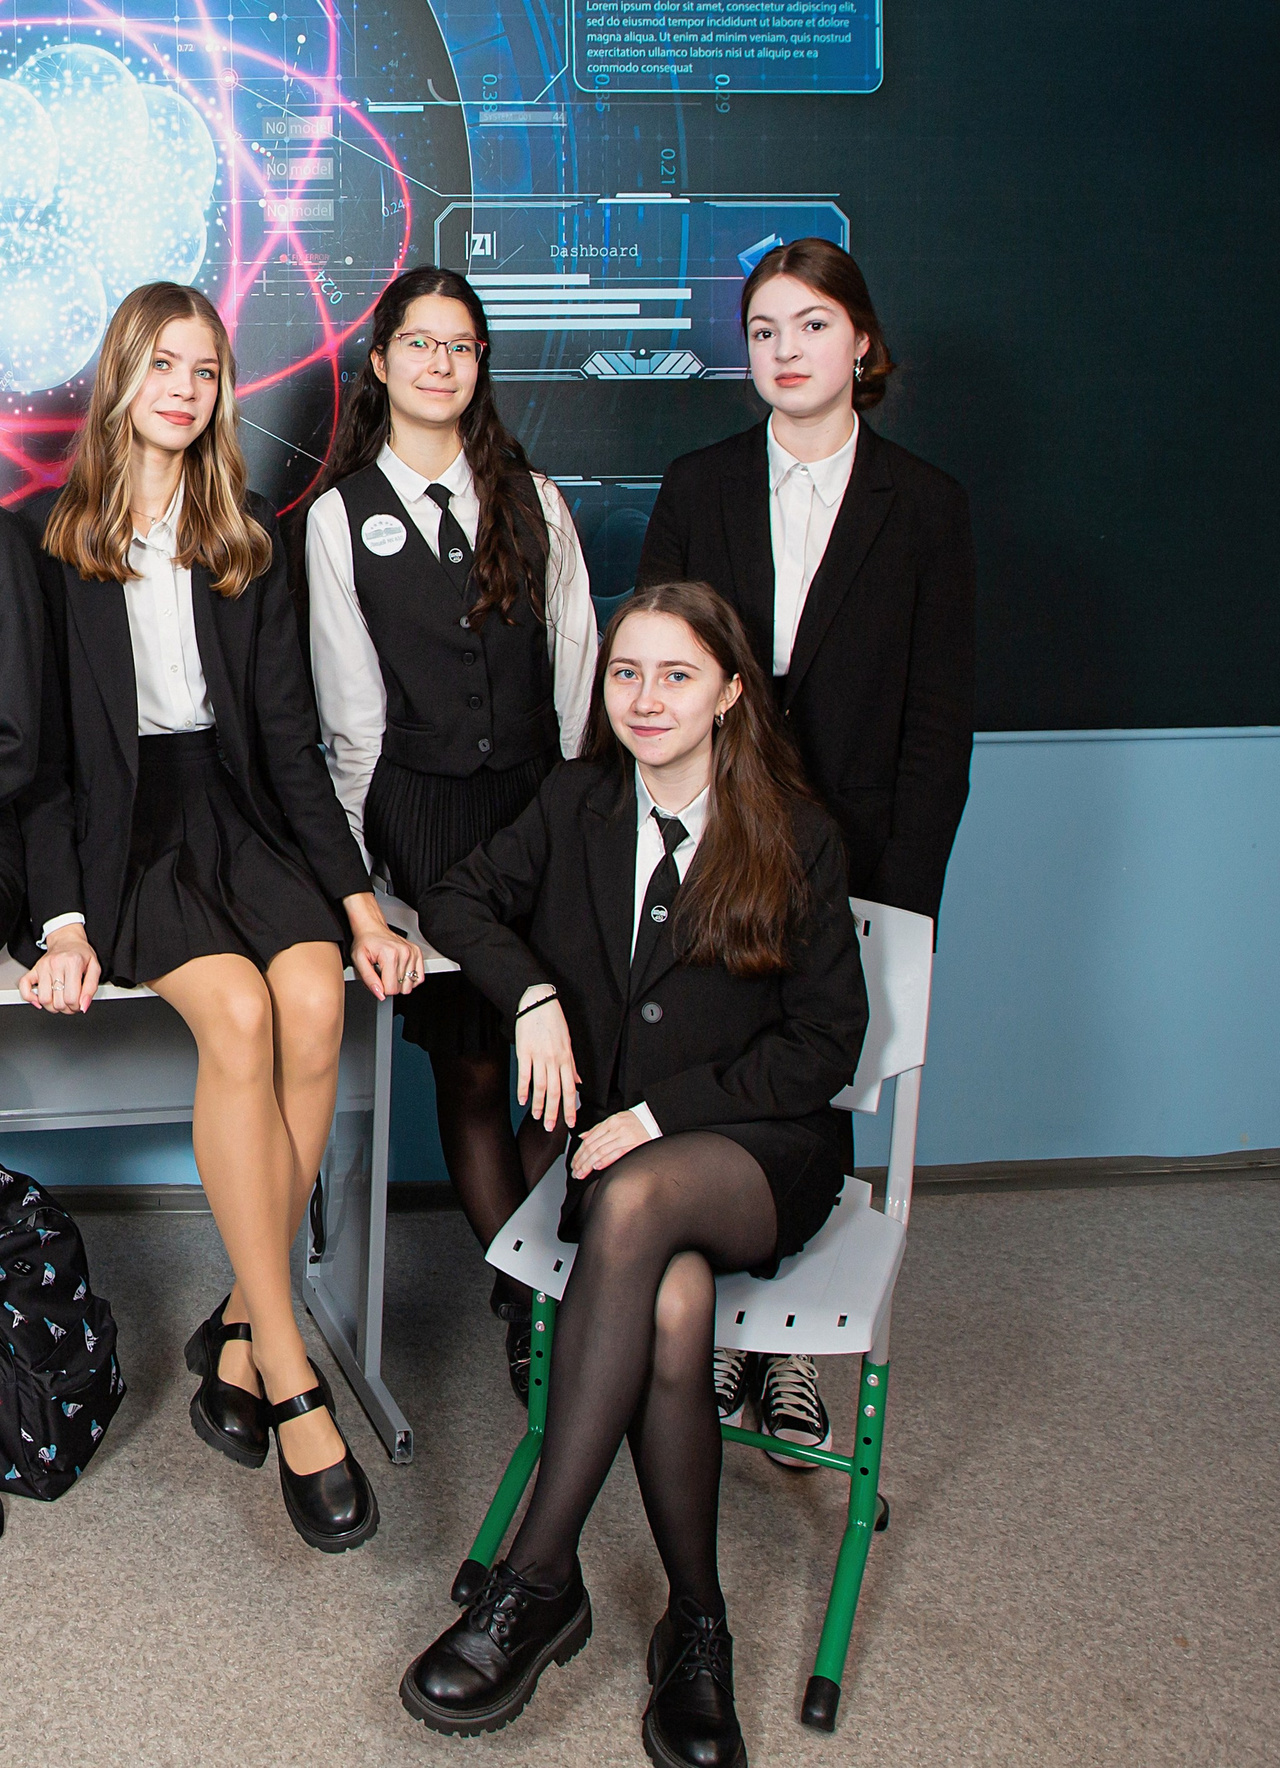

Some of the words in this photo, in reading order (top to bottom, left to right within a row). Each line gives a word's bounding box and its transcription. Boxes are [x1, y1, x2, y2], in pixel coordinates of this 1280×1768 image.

[586, 1, 618, 11] Lorem
[621, 1, 651, 13] ipsum
[654, 1, 680, 11] dolor
[682, 2, 694, 11] sit
[696, 2, 724, 13] amet,
[726, 2, 784, 12] consectetur
[786, 2, 836, 15] adipiscing
[838, 2, 857, 13] elit,
[586, 16, 604, 27] sed
[606, 16, 620, 27] do
[622, 16, 666, 27] eiusmod
[667, 18, 704, 29] tempor
[707, 16, 757, 27] incididunt
[760, 18, 769, 27] ut
[772, 17, 803, 27] labore
[805, 18, 815, 27] et
[817, 17, 849, 27] dolore
[587, 33, 621, 44] magna
[624, 32, 657, 44] aliqua.
[659, 32, 671, 42] Ut
[672, 32, 698, 42] enim
[700, 32, 713, 42] ad
[715, 32, 747, 42] minim
[749, 32, 788, 44] veniam,
[790, 32, 811, 45] quis
[813, 32, 852, 43] nostrud
[177, 44, 194, 52] 0.72
[587, 47, 645, 58] exercitation
[648, 47, 688, 58] ullamco
[689, 47, 723, 58] laboris
[725, 47, 742, 58] nisi
[744, 49, 755, 58] ut
[756, 47, 791, 60] aliquip
[793, 49, 805, 58] ex
[806, 49, 819, 58] ea
[587, 62, 639, 73] commodo
[641, 63, 694, 75] consequat
[482, 74, 498, 113] 0.38
[715, 74, 730, 113] 0.29
[266, 122, 286, 134] NO
[290, 121, 331, 134] model
[267, 163, 287, 176] NO
[290, 162, 331, 176] model
[660, 148, 676, 184] 0.21
[267, 204, 288, 217] NO
[291, 203, 332, 217] model
[382, 199, 405, 217] 0.24
[550, 244, 638, 257] Dashboard
[314, 270, 342, 305] 0.24
[341, 371, 358, 383] 0.2
